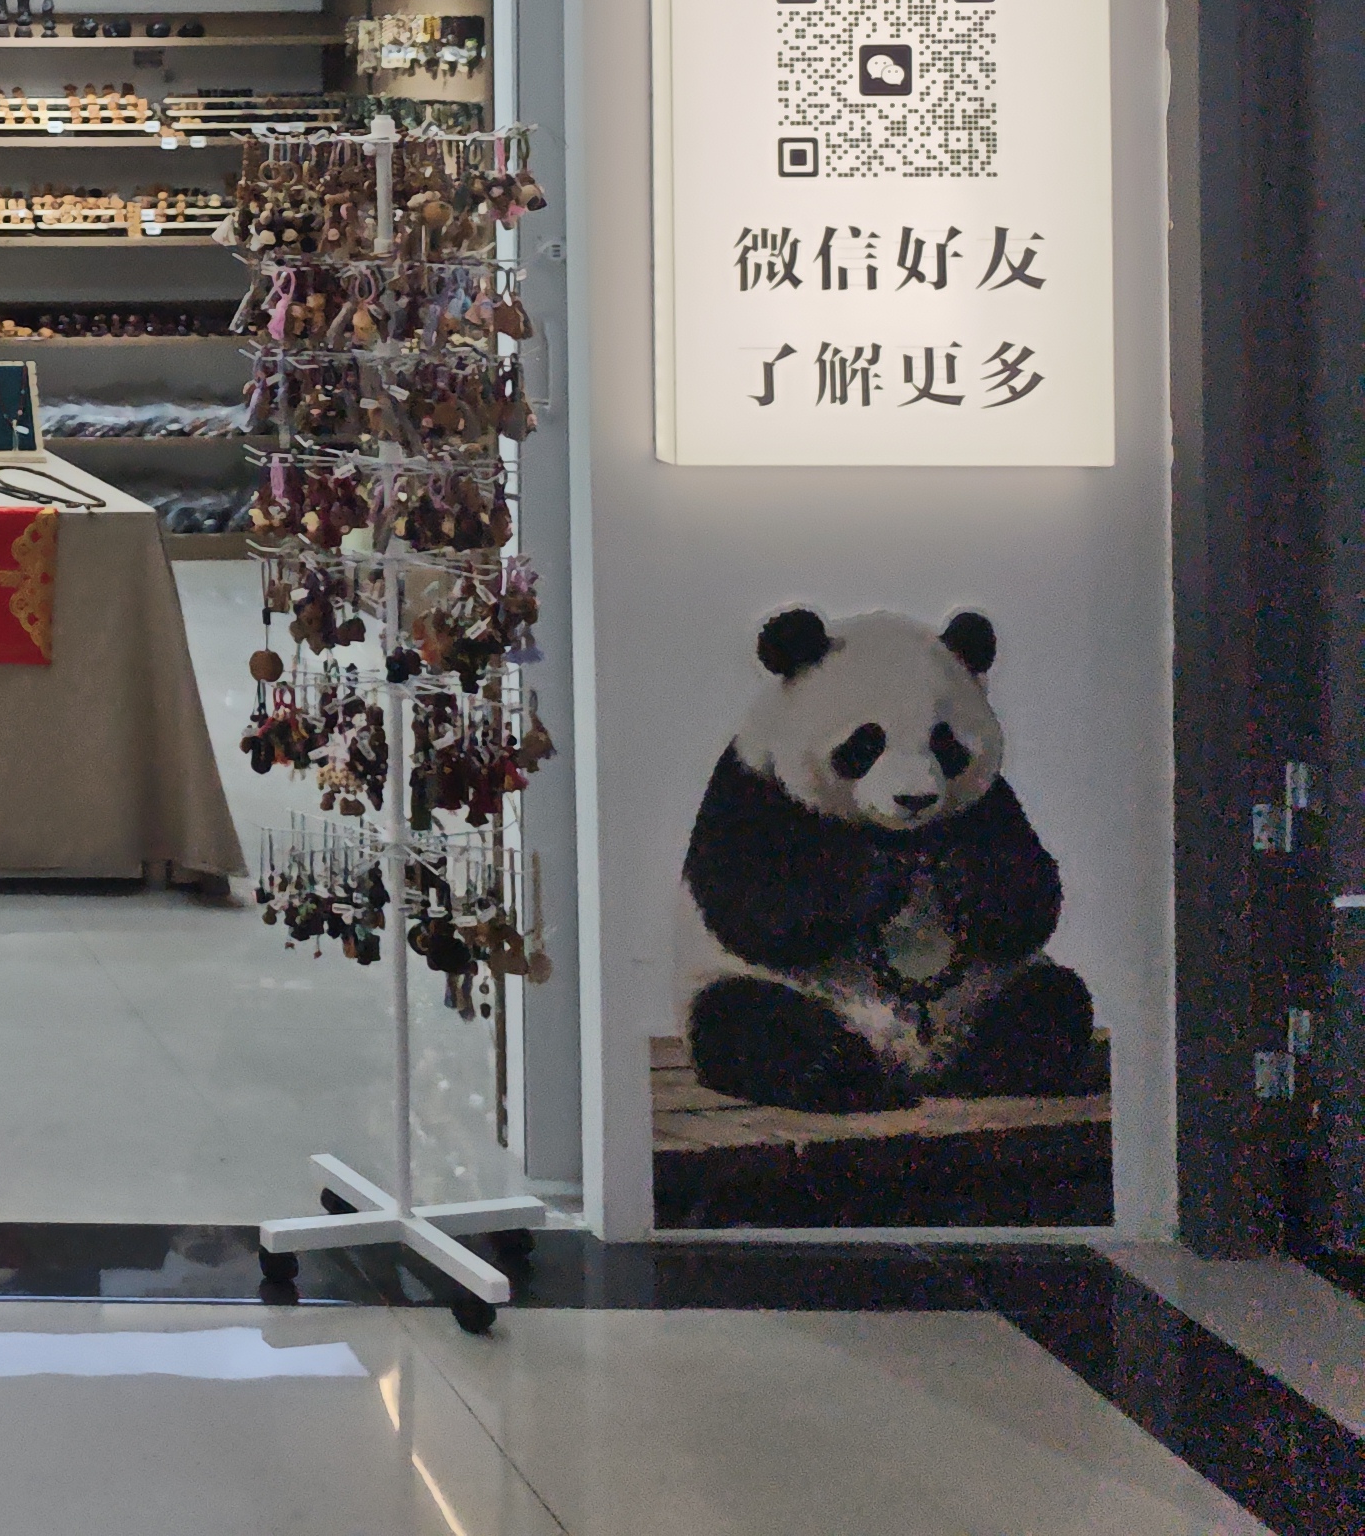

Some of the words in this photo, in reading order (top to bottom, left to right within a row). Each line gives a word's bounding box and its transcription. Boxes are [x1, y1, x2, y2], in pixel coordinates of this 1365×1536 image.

[734, 225, 1047, 292] 微信好友
[739, 341, 1046, 409] 了解更多
